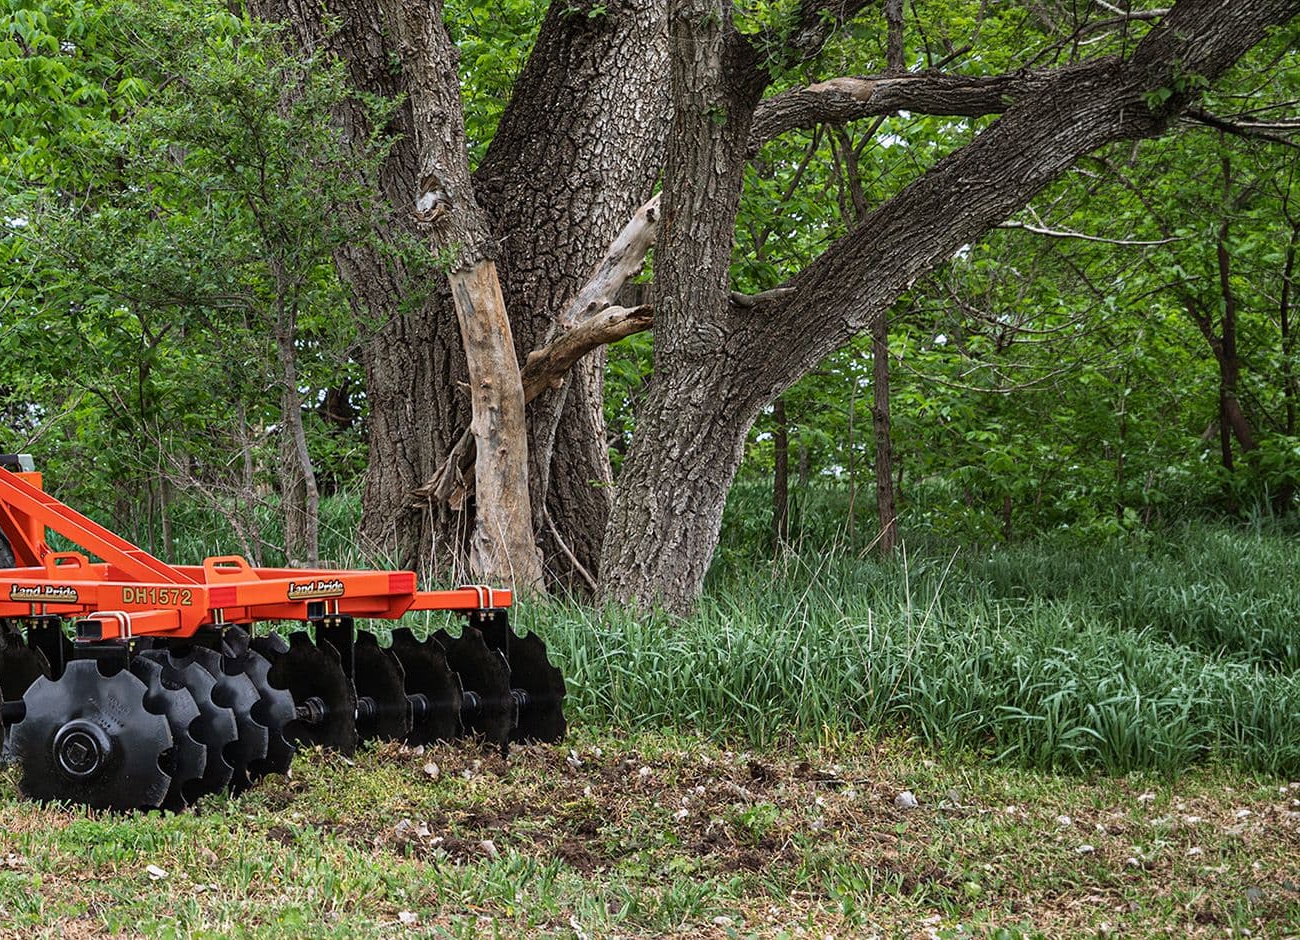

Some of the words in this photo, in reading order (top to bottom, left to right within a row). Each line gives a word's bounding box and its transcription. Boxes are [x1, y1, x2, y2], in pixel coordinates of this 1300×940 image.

[11, 584, 42, 596] Land
[45, 586, 77, 598] Pride
[289, 582, 315, 593] Land
[317, 580, 343, 592] Pride
[123, 587, 192, 605] DH1572
